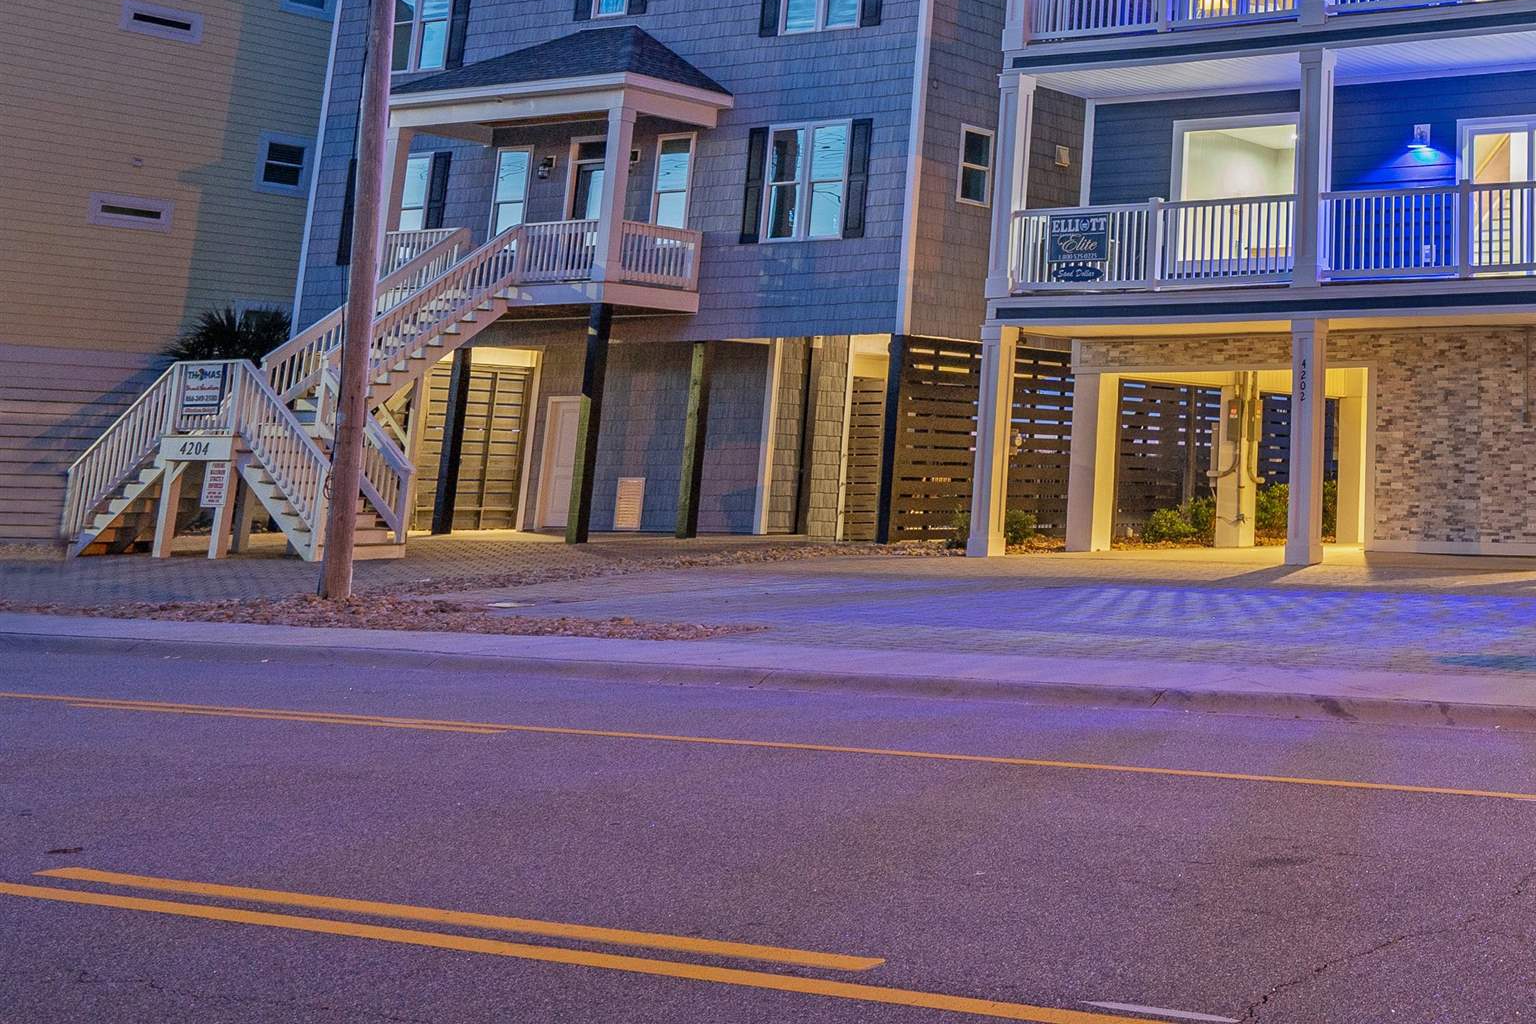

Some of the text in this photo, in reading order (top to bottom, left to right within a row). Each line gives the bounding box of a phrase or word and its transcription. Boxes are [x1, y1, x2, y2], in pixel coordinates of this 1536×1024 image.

[1052, 217, 1107, 233] ELLIOTT
[1057, 233, 1098, 254] Elite
[180, 442, 210, 455] 4204
